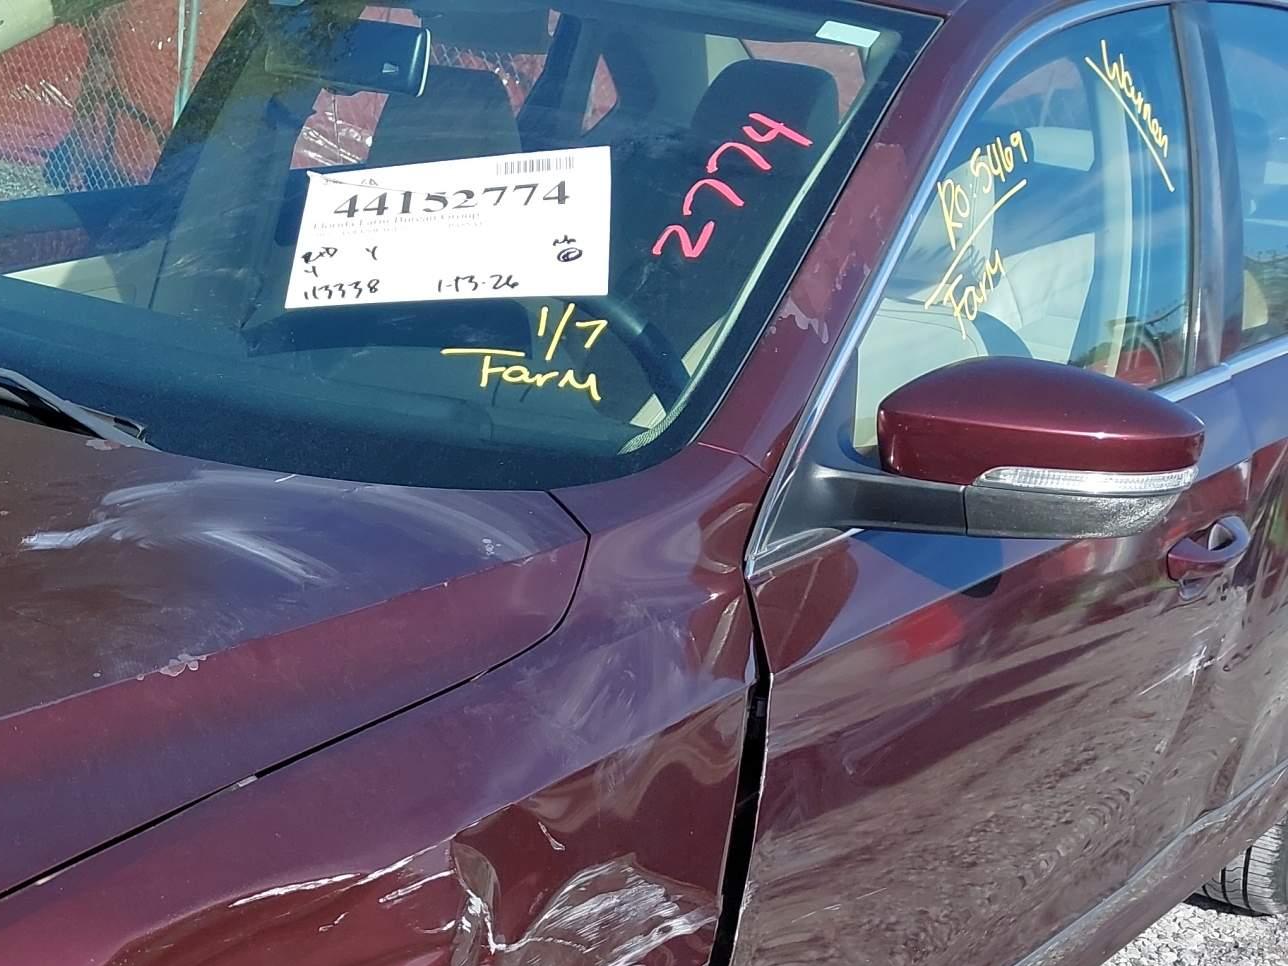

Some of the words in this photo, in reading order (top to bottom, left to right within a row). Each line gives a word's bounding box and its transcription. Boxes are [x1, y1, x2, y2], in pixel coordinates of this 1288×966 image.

[333, 180, 571, 218] 44152774
[652, 112, 814, 258] 2774
[303, 278, 380, 300] 113338
[537, 302, 608, 361] 1/7
